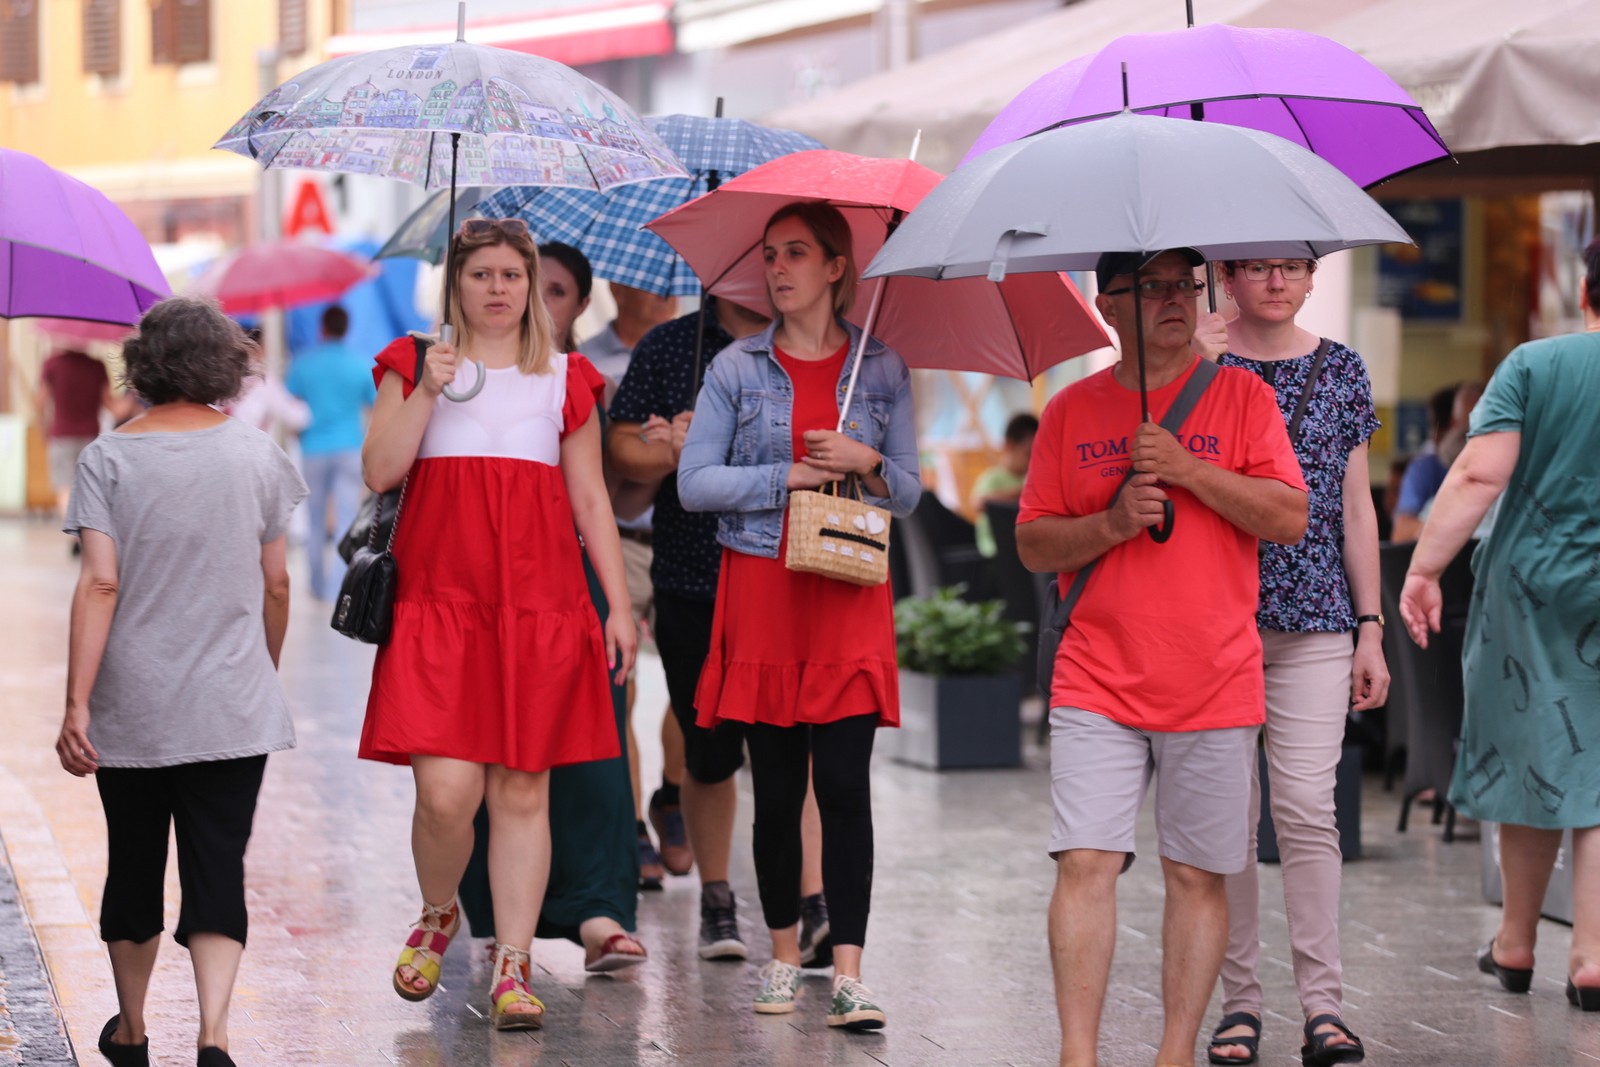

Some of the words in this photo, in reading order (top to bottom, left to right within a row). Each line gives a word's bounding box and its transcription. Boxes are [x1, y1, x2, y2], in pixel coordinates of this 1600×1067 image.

[387, 69, 443, 80] LONDON
[1076, 436, 1129, 462] TOM
[1101, 466, 1129, 478] GEN
